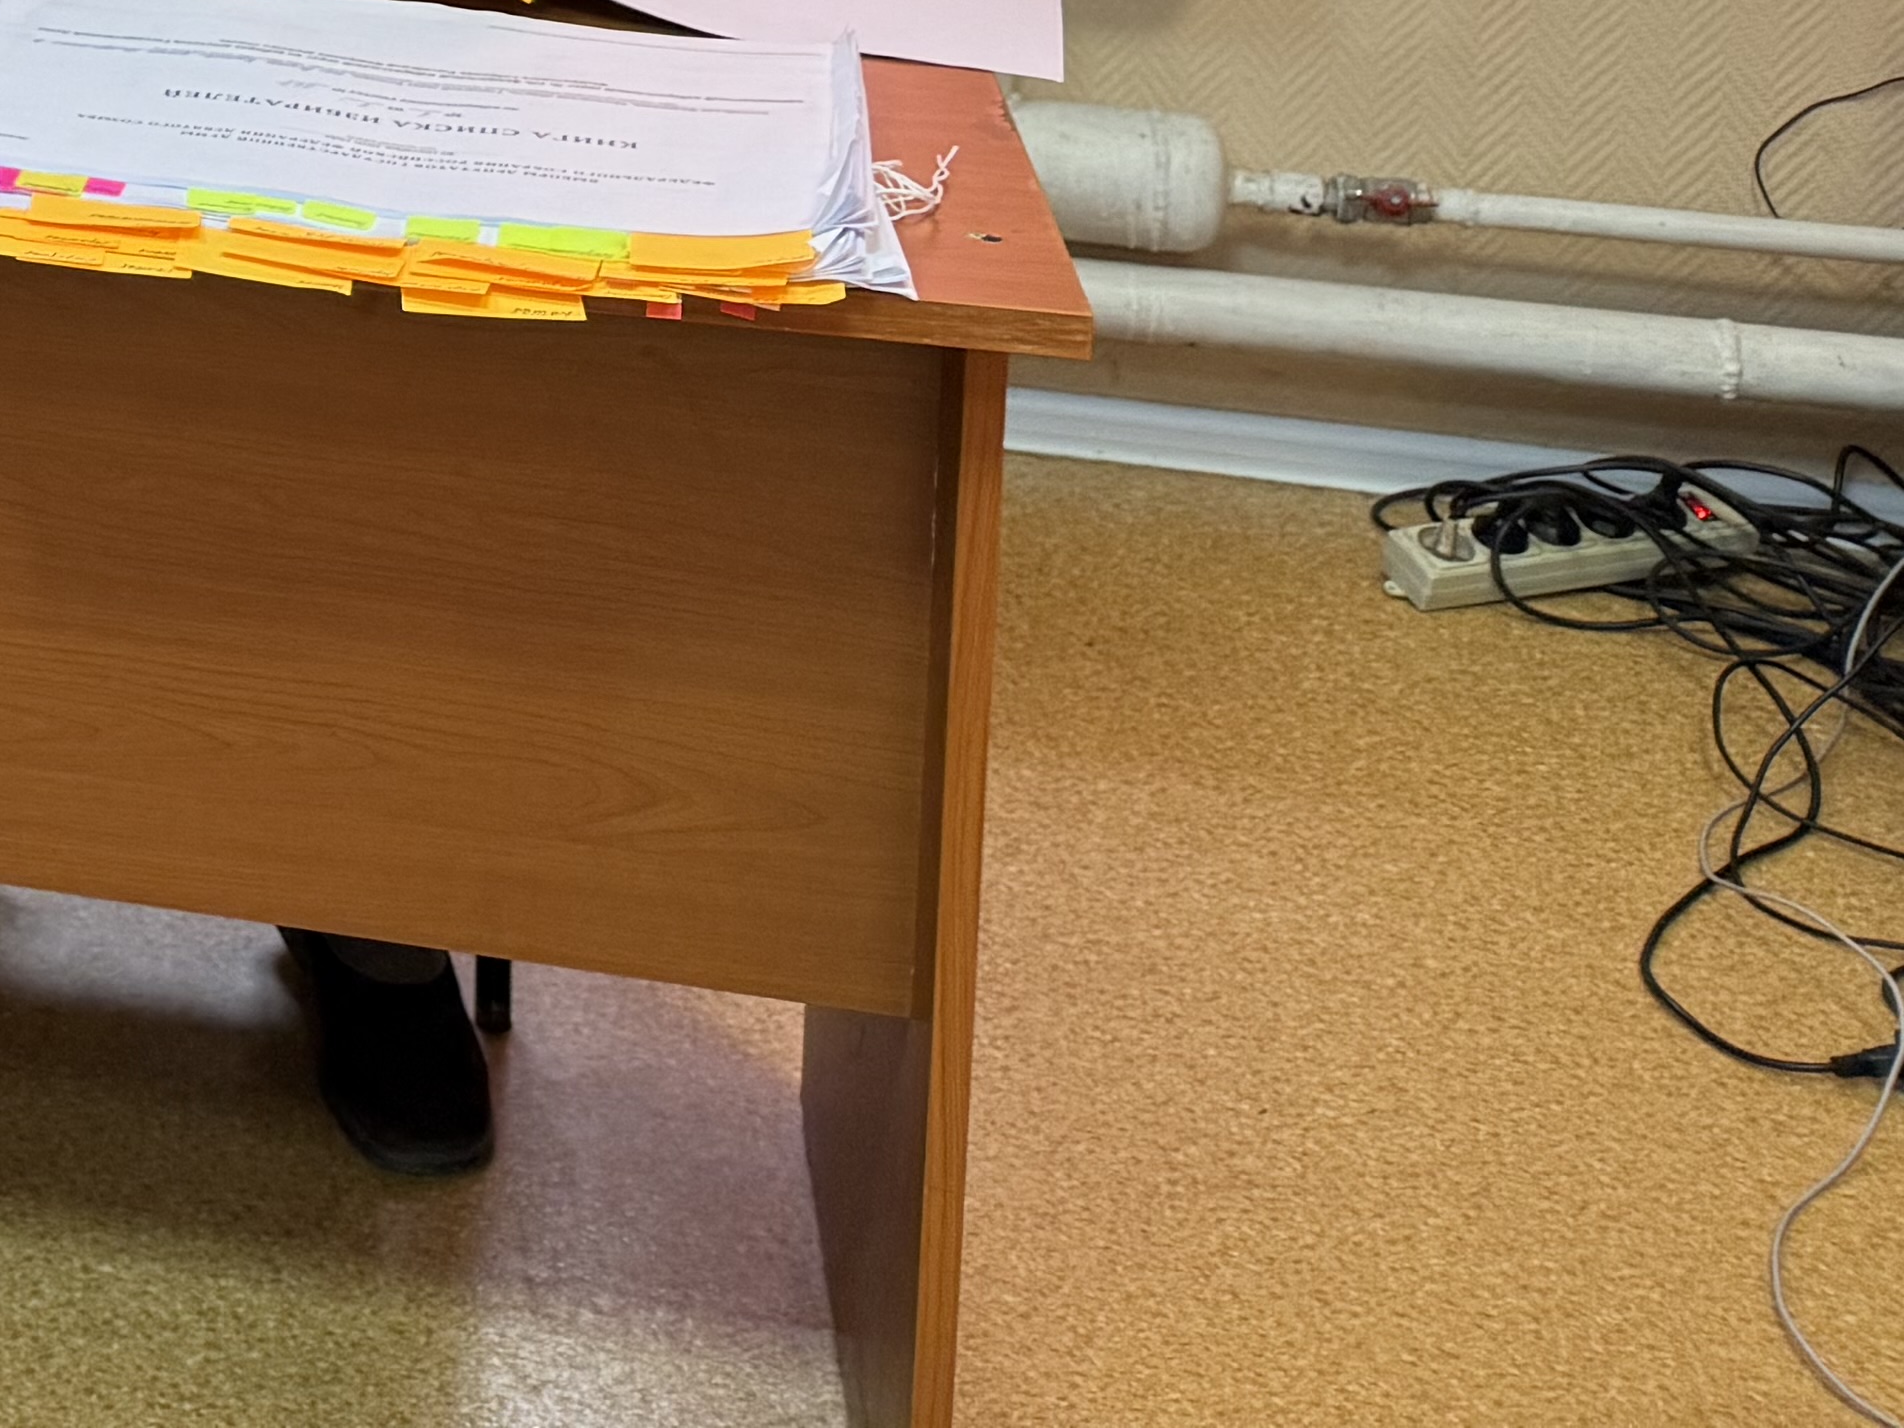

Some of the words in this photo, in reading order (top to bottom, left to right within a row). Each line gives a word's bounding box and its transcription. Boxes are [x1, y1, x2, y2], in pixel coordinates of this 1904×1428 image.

[164, 89, 380, 123] ИЗБИРАТЕЛЕЙ
[392, 120, 521, 136] СПИСКА
[532, 131, 638, 149] КНИГА
